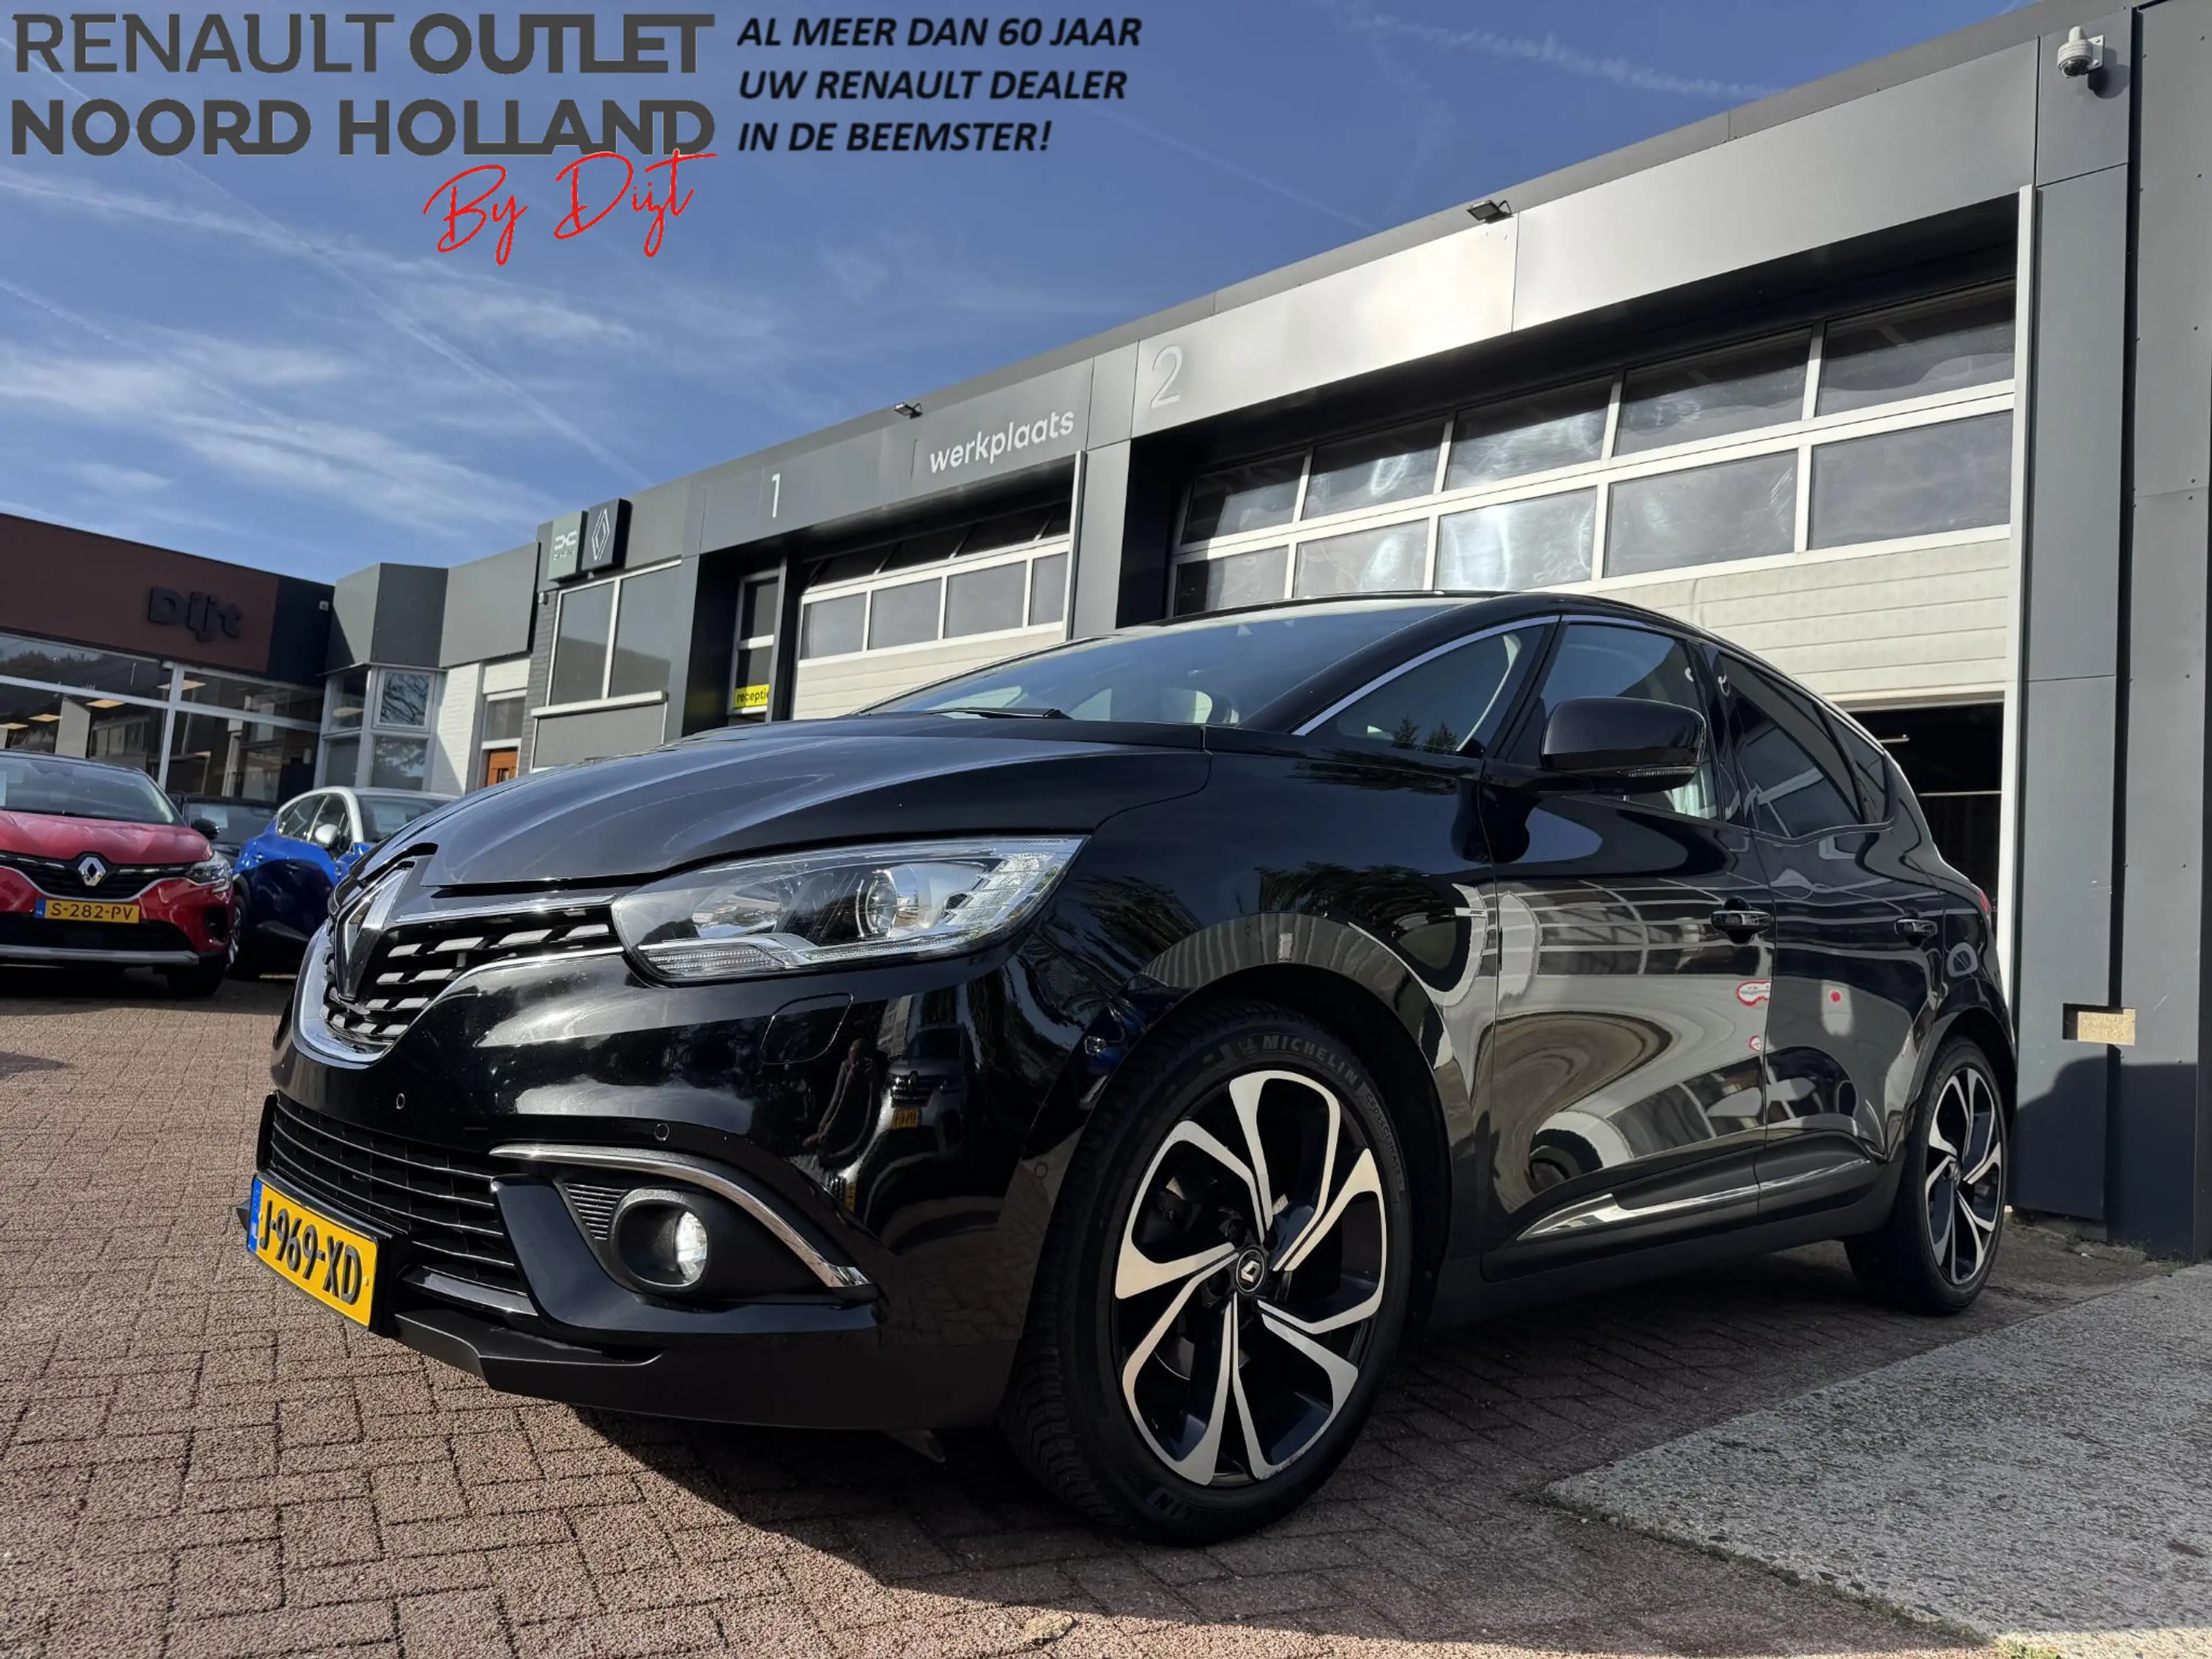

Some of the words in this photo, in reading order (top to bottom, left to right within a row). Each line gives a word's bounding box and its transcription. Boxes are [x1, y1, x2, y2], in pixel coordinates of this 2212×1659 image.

[1149, 344, 1183, 411] 2
[929, 410, 1075, 475] werkplaats
[771, 472, 781, 519] 1
[148, 586, 244, 642] Dijt
[51, 903, 133, 921] S-282-PV
[1262, 1034, 1358, 1086] MICHELIN
[259, 1199, 362, 1306] J-969-XD
